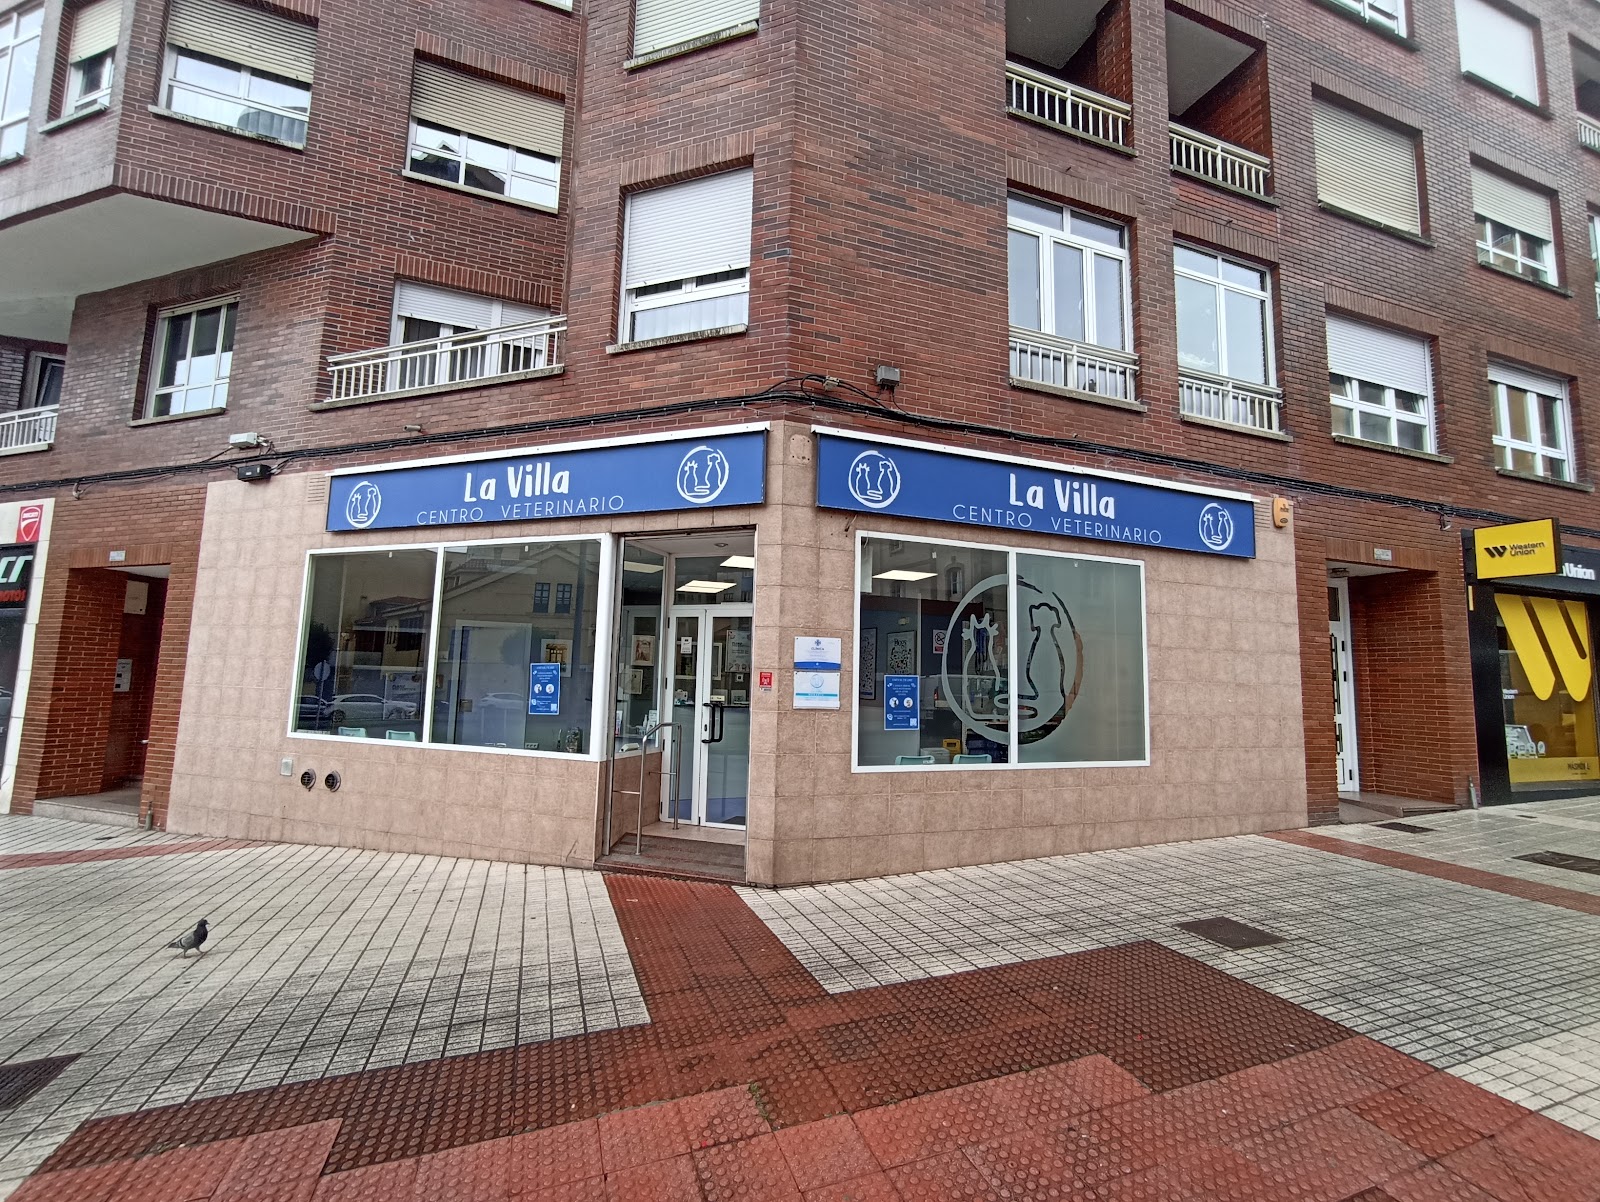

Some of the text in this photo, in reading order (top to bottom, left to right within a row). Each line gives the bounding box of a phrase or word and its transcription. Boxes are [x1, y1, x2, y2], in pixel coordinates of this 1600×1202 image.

[464, 462, 570, 502] La Villa
[1009, 473, 1115, 520] La Villa
[416, 495, 624, 525] CENTRO VETERINARIO
[953, 504, 1162, 544] CENTRO VETERINARIO
[1509, 541, 1545, 550] Western
[1510, 548, 1535, 557] Union
[1565, 562, 1595, 580] Union
